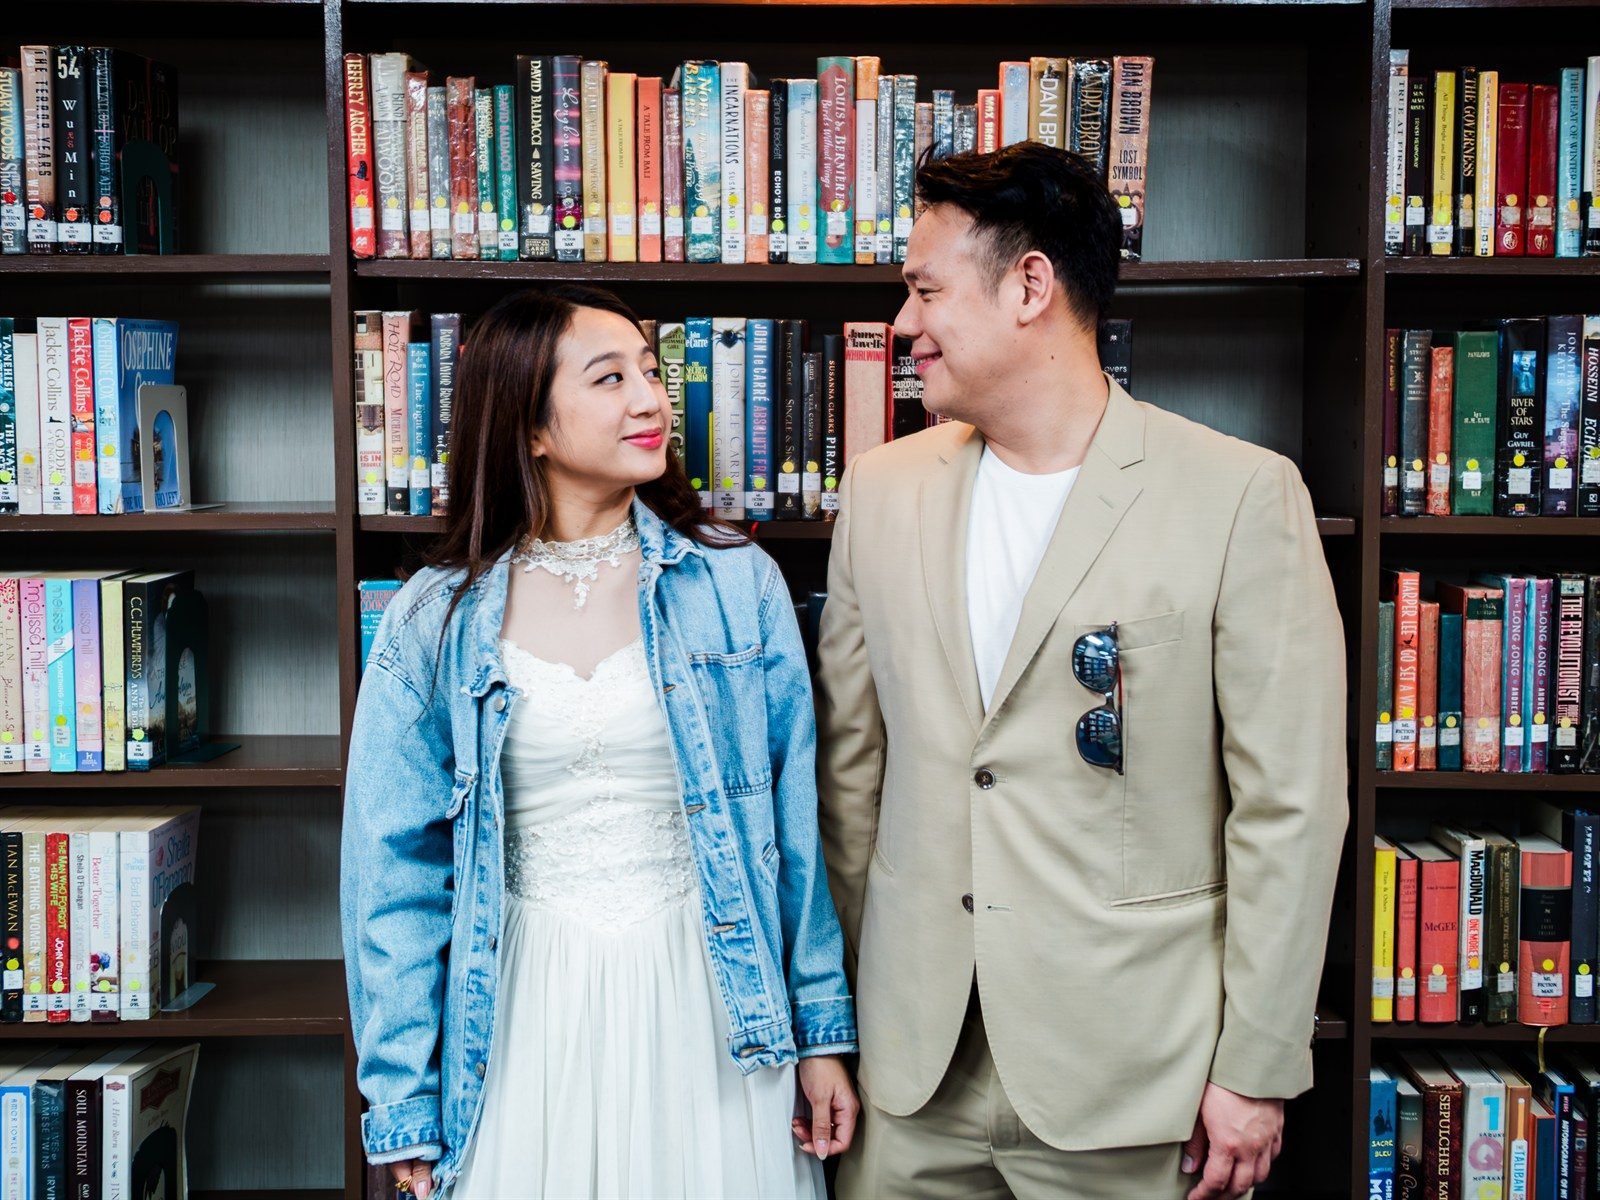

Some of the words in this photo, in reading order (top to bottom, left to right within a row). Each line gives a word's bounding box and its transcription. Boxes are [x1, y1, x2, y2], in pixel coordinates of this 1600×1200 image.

[35, 50, 47, 72] THE
[57, 56, 80, 79] 54
[530, 60, 542, 92] DAVID
[1121, 62, 1144, 86] DAN
[0, 71, 12, 112] STUART
[348, 59, 365, 106] JEFFREY
[684, 63, 699, 128] BARBER
[835, 77, 846, 119] LOUIS
[1039, 78, 1059, 117] DAN
[1464, 78, 1476, 103] THE
[1571, 72, 1579, 93] THE
[36, 81, 49, 129] TERROR
[531, 95, 542, 145] BALDACCI
[821, 99, 833, 126] Birds
[1119, 91, 1142, 134] BROWN
[1440, 104, 1448, 123] Things
[1570, 96, 1578, 118] HEAT
[2, 115, 15, 159] WOODS
[25, 108, 39, 172] LAWRENCE
[350, 109, 365, 156] ARCHER
[554, 88, 579, 162] Longbourn
[725, 85, 739, 164] INCARNATIONS
[1570, 121, 1578, 139] OF
[38, 137, 51, 176] YEARS
[500, 126, 512, 171] BALDACCI
[823, 129, 833, 159] Without
[1119, 150, 1138, 164] LOST
[1463, 106, 1476, 177] GOVERNESS
[377, 128, 394, 194] ATWOOD
[686, 161, 697, 187] Prince
[821, 163, 832, 188] Wings
[1112, 166, 1143, 180] SYMBOL
[1439, 156, 1447, 180] Beautiful
[1569, 142, 1577, 180] WINTER
[532, 162, 542, 199] SAVING
[41, 323, 61, 364] Jackie
[70, 323, 91, 365] Jackie
[440, 329, 452, 360] BARBARA
[753, 324, 767, 351] JOHN
[120, 324, 172, 389] JOSEPHINE
[755, 355, 767, 364] le
[1557, 344, 1566, 384] KEATES
[1567, 332, 1576, 395] JONATHAN
[47, 368, 63, 411] Collins
[76, 368, 94, 412] Collins
[415, 381, 425, 401] The
[726, 362, 742, 400] JOHN
[755, 368, 769, 402] CARRÉ
[1587, 347, 1599, 402] HOSSEINI
[439, 388, 452, 424] BRADFORD
[785, 399, 794, 432] SINGLE
[1511, 398, 1534, 407] RIVER
[1516, 408, 1527, 416] OF
[1561, 400, 1570, 418] The
[5, 422, 13, 446] THE
[391, 408, 403, 444] MICHAEL
[731, 413, 742, 428] LE
[753, 405, 767, 455] ABSOLUTE
[1510, 416, 1534, 426] STARS
[1558, 422, 1569, 447] Siege
[714, 438, 722, 489] GARDENER
[28, 586, 44, 645] melissa
[52, 586, 64, 634] melissa
[1401, 579, 1417, 619] HARPER
[1562, 597, 1582, 617] THE
[1401, 621, 1417, 636] LEE
[1512, 610, 1520, 641] LONG
[1538, 610, 1547, 642] LONG
[6, 628, 14, 662] LIAN
[30, 651, 45, 670] hill
[53, 638, 65, 653] hill
[1401, 649, 1416, 663] GO
[1511, 644, 1520, 676] SONG
[1538, 645, 1547, 676] SONG
[1400, 666, 1415, 681] SET
[1558, 621, 1581, 703] REVOLUTIONIST
[7, 844, 17, 868] IAN
[29, 844, 40, 864] THE
[59, 841, 67, 854] THE
[59, 856, 67, 874] MAN
[92, 857, 101, 885] Better
[29, 867, 41, 911] BATHING
[50, 881, 58, 906] WIFE
[59, 876, 67, 894] WHO
[7, 873, 18, 932] McEWAN
[58, 896, 67, 929] FORGOT
[91, 887, 101, 929] Together
[30, 914, 41, 953] WOMEN
[1424, 922, 1457, 931] McGEE
[55, 938, 64, 959] JOHN
[76, 1090, 87, 1115] SOUL
[76, 1120, 87, 1175] MOUNTAIN
[1438, 1095, 1450, 1176] SEPULCHRE
[1560, 1120, 1569, 1176] AUTOBIOGRAPHY
[1514, 1151, 1524, 1192] TALIBAN
